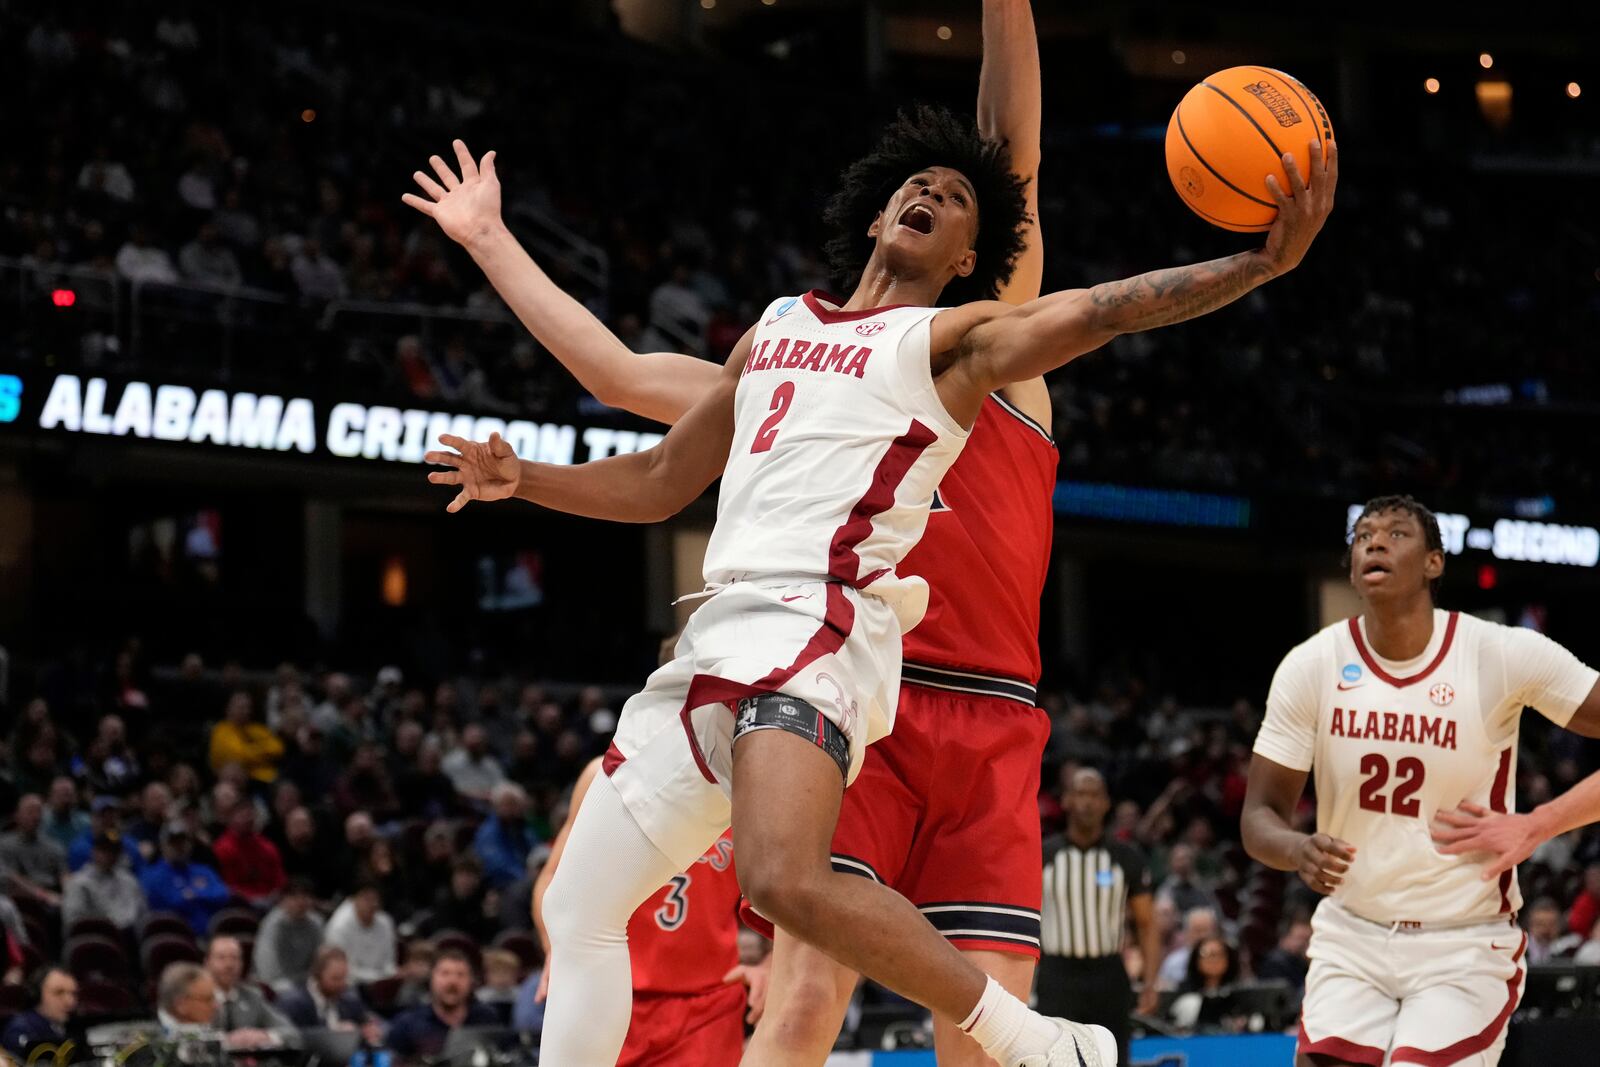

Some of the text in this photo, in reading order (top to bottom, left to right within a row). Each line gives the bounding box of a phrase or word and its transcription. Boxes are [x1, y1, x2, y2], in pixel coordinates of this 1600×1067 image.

[856, 322, 886, 337] SEC
[743, 338, 872, 379] ALABAMA
[40, 375, 315, 453] ALABAMA
[750, 381, 795, 454] 2
[1430, 684, 1455, 706] SEC
[1331, 708, 1457, 750] ALABAMA
[1359, 753, 1426, 818] 22
[655, 873, 692, 931] 3
